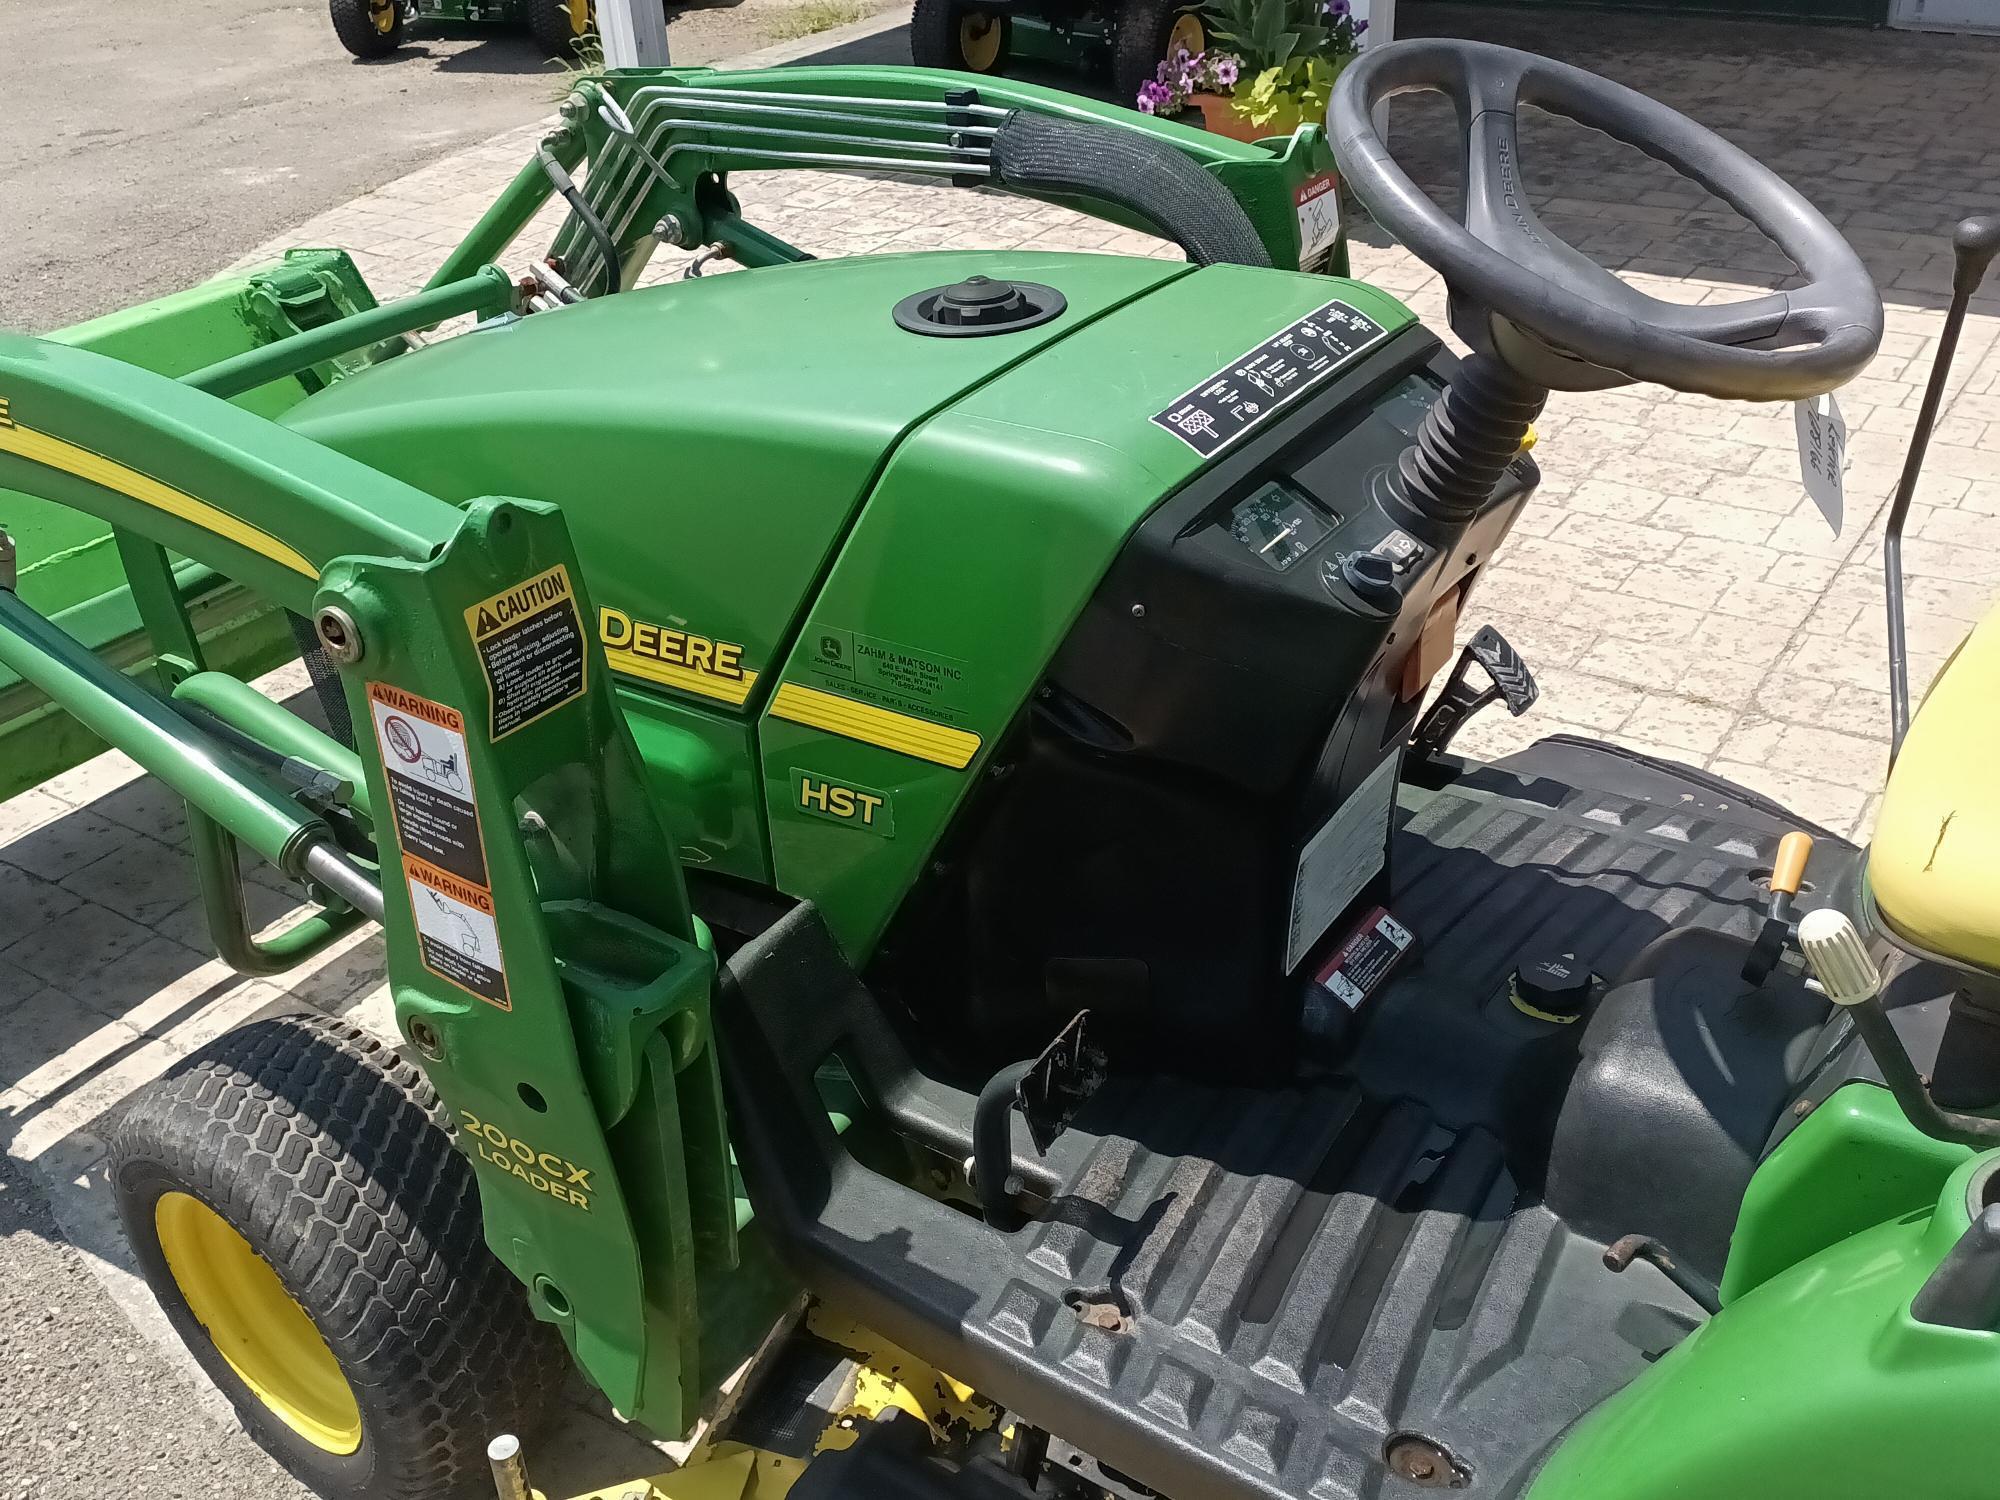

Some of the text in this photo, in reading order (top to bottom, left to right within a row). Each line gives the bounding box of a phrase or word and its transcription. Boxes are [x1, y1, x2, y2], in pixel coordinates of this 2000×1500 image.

[1307, 178, 1331, 197] DANGER
[1497, 136, 1519, 210] DEERE
[496, 572, 566, 623] CAUTION
[485, 609, 562, 653] Lock loader latches before
[488, 641, 518, 662] operating
[490, 623, 568, 669] Before servicing, adjusting
[599, 605, 744, 677] DEERE
[493, 629, 574, 677] equipment or disconnecting
[505, 672, 524, 687] Lower
[524, 662, 544, 677] loader
[544, 658, 550, 666] to
[551, 647, 572, 664] ground
[810, 655, 853, 672] JOHN DEERE
[857, 644, 964, 681] ZAHM & MATSON INC.
[902, 667, 917, 677] Main
[495, 674, 504, 684] oil
[506, 688, 520, 701] Shut
[530, 673, 550, 689] engine
[550, 667, 561, 677] and
[514, 673, 537, 690] support
[383, 687, 459, 729] WARNING
[498, 700, 523, 718] Observe
[801, 778, 882, 825] HST
[419, 866, 490, 911] WARNING
[1345, 932, 1364, 953] DANGER
[460, 1109, 593, 1192] 200CX
[477, 1141, 589, 1211] LOADER
